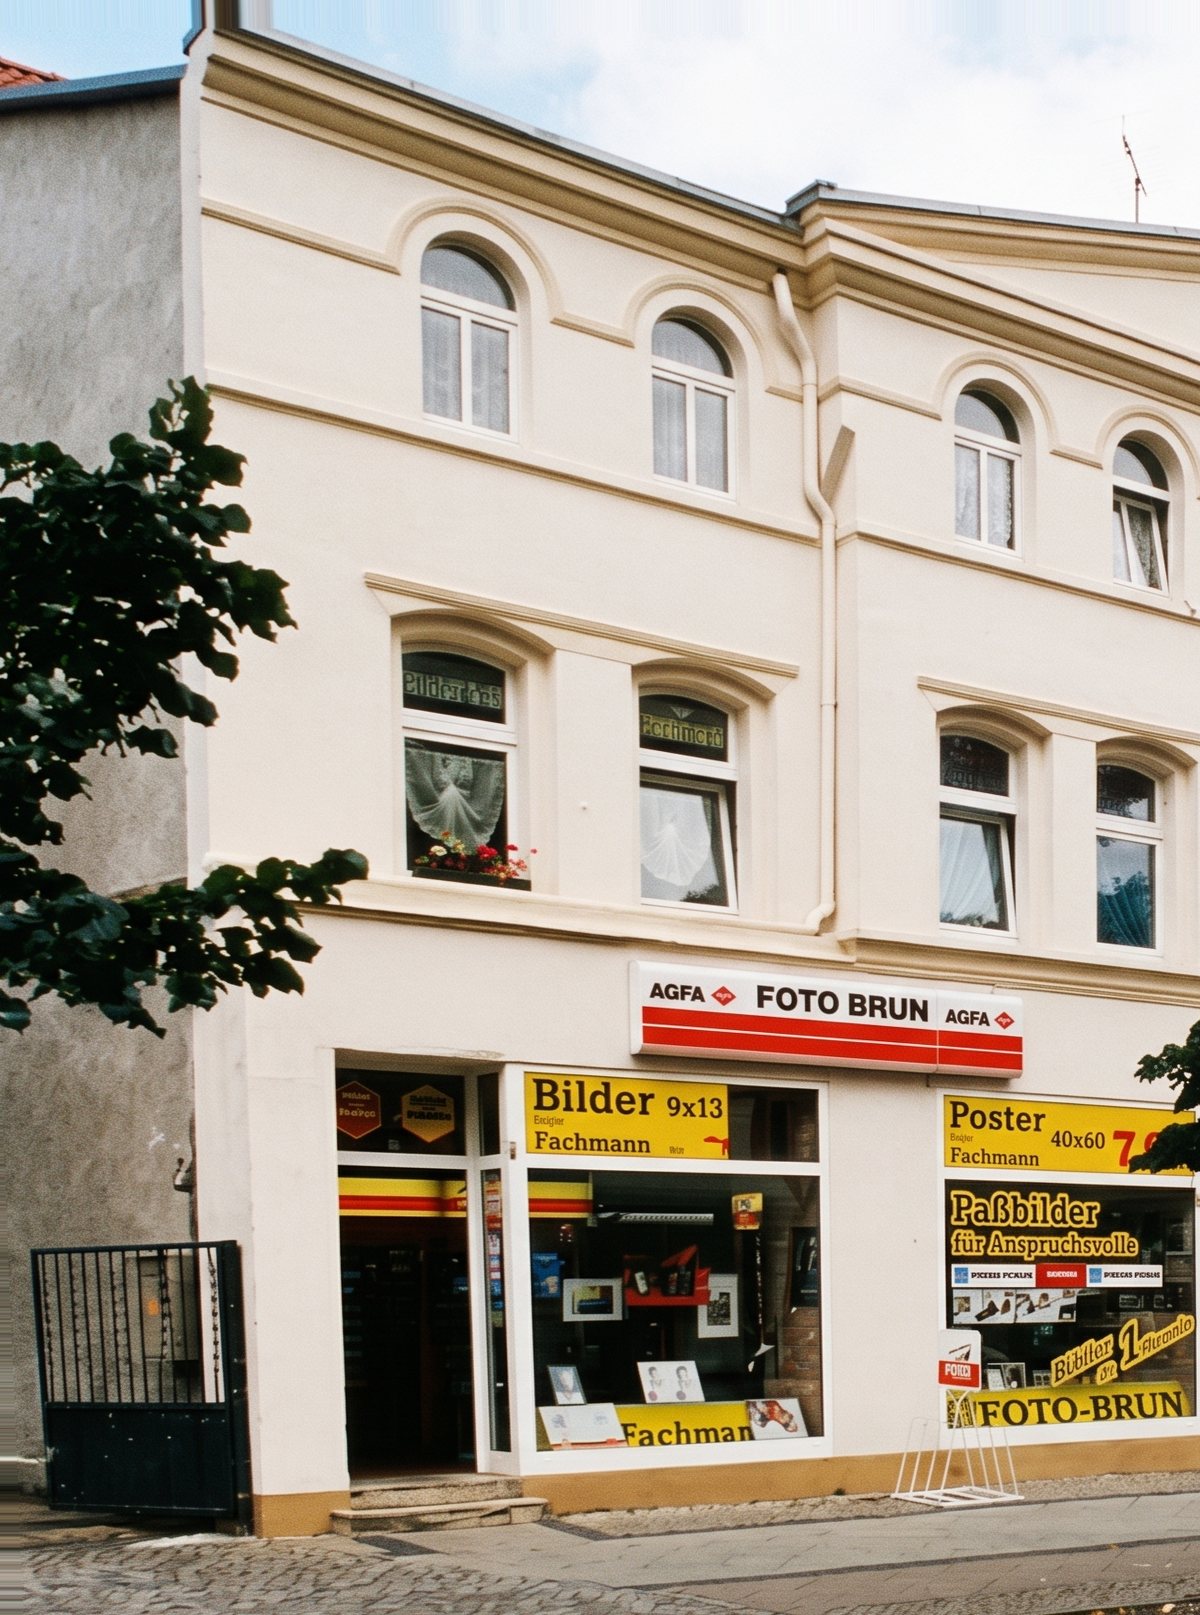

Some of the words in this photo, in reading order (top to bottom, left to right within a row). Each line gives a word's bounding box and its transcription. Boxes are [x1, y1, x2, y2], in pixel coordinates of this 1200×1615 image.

[650, 982, 706, 1003] AGFA
[756, 985, 839, 1014] FOTO
[848, 992, 929, 1023] BRUN
[945, 1009, 990, 1027] AGFA
[532, 1078, 655, 1115] Bilder
[666, 1096, 723, 1119] 9x13
[950, 1101, 1046, 1132] Poster
[534, 1131, 651, 1153] Fachmann
[1050, 1130, 1106, 1149] 40x60
[950, 1147, 1040, 1166] Fachmann
[951, 1190, 1100, 1228] Paßbilder
[951, 1229, 987, 1256] für
[987, 1231, 1139, 1261] Anspruchsvolle
[978, 1391, 1182, 1427] FOTO-BRUN
